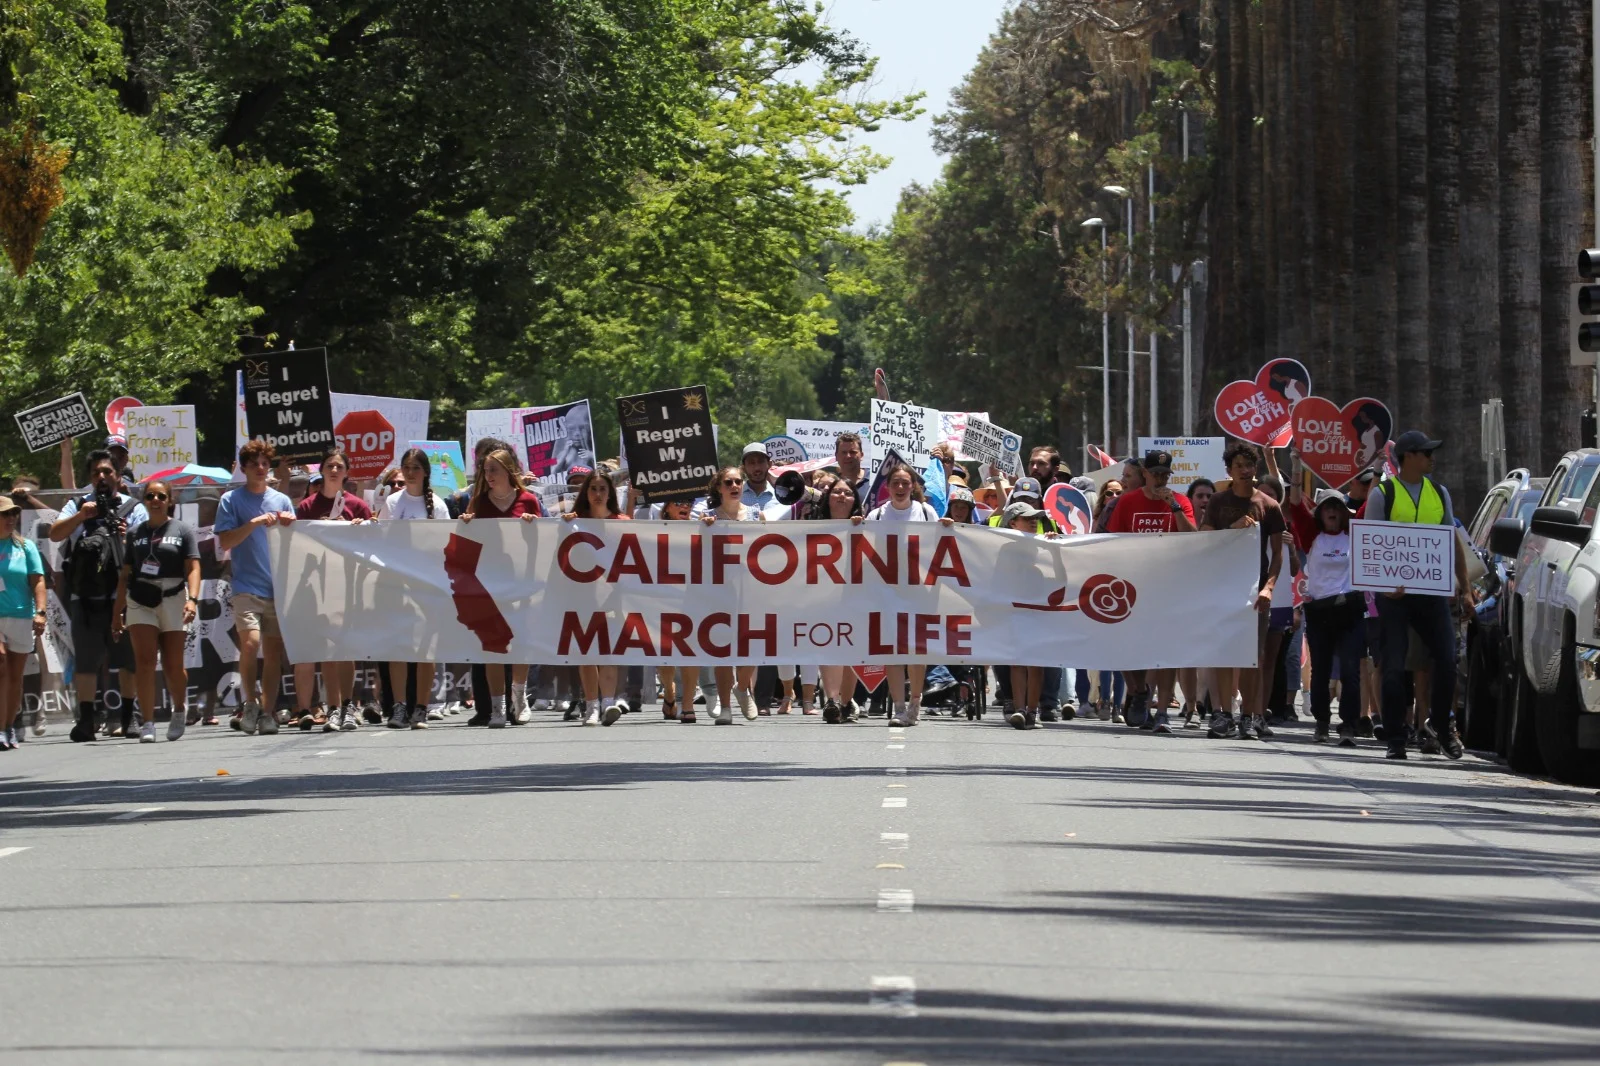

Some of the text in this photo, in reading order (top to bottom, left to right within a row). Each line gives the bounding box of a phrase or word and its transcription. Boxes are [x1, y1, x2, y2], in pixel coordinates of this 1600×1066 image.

[282, 367, 289, 381] I
[257, 385, 319, 407] Regret
[661, 406, 670, 420] I
[876, 400, 896, 414] You
[1225, 391, 1269, 422] LOVE
[1254, 401, 1276, 416] them
[22, 403, 85, 433] DEFUND
[127, 410, 167, 429] Before
[171, 409, 188, 429] I
[277, 409, 303, 427] My
[875, 411, 924, 431] Have To Be
[1239, 402, 1285, 434] BOTH
[1297, 418, 1343, 436] LOVE
[26, 413, 89, 442] PLANNED
[30, 421, 92, 448] PARENTHOOD
[525, 415, 568, 447] BABIES
[636, 422, 702, 444] Regret
[794, 427, 809, 436] the
[811, 427, 830, 437] 70's
[873, 422, 913, 440] Catholic
[913, 430, 926, 442] To
[967, 417, 1005, 440] LIFE IS THE
[128, 432, 176, 449] Formed
[334, 430, 394, 453] STOP
[765, 439, 788, 450] PRAY
[802, 442, 816, 450] HEY
[872, 434, 932, 456] Oppose Killin
[965, 428, 983, 441] FIRST
[983, 436, 1002, 450] RIGHT
[1153, 438, 1210, 446] #WHYWEMARCH
[1323, 431, 1346, 443] them
[658, 446, 686, 463] My
[775, 447, 795, 457] END
[1170, 449, 1185, 458] IFE
[1302, 438, 1352, 455] BOTH
[127, 453, 149, 470] you
[170, 448, 192, 463] the
[354, 454, 391, 463] TRAFFICKING
[962, 445, 976, 459] RIGHT
[976, 451, 985, 461] TO
[995, 459, 1015, 475] LEAGUE
[1171, 462, 1200, 471] AMILY
[635, 464, 717, 486] Abortion
[1138, 518, 1165, 526] PRAY
[161, 536, 183, 547] LIFE
[1361, 533, 1442, 550] EQUALITY
[557, 531, 972, 588] CALIFORNIA
[1361, 549, 1442, 565] BEGINS IN
[1362, 564, 1443, 581] THE WOMB
[556, 611, 972, 658] MARCH FOR LIFE
